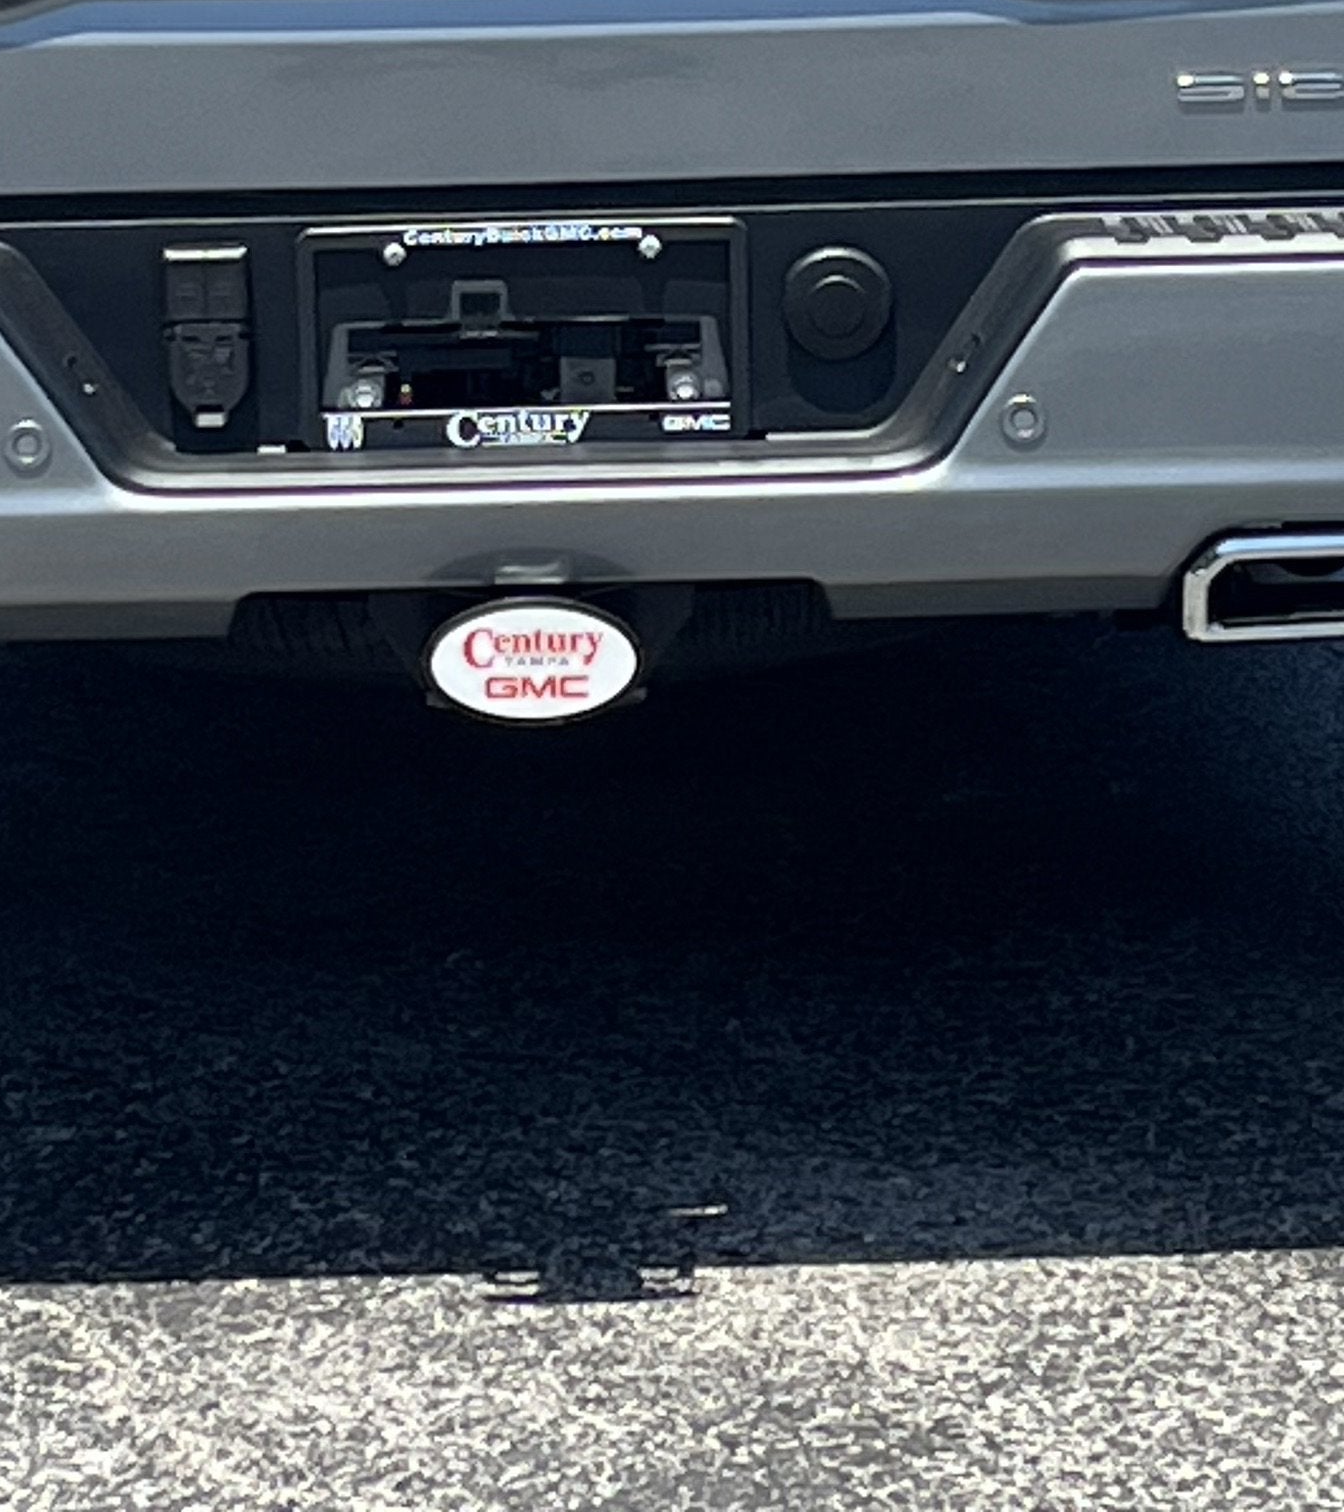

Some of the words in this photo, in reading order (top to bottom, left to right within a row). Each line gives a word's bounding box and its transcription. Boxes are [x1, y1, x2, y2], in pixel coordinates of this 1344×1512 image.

[403, 224, 643, 247] CenturyBuickGMC.com
[445, 409, 591, 448] Century
[662, 414, 731, 431] GMC
[462, 628, 604, 669] Century
[505, 656, 570, 667] TAMPA
[484, 674, 590, 699] GMC
